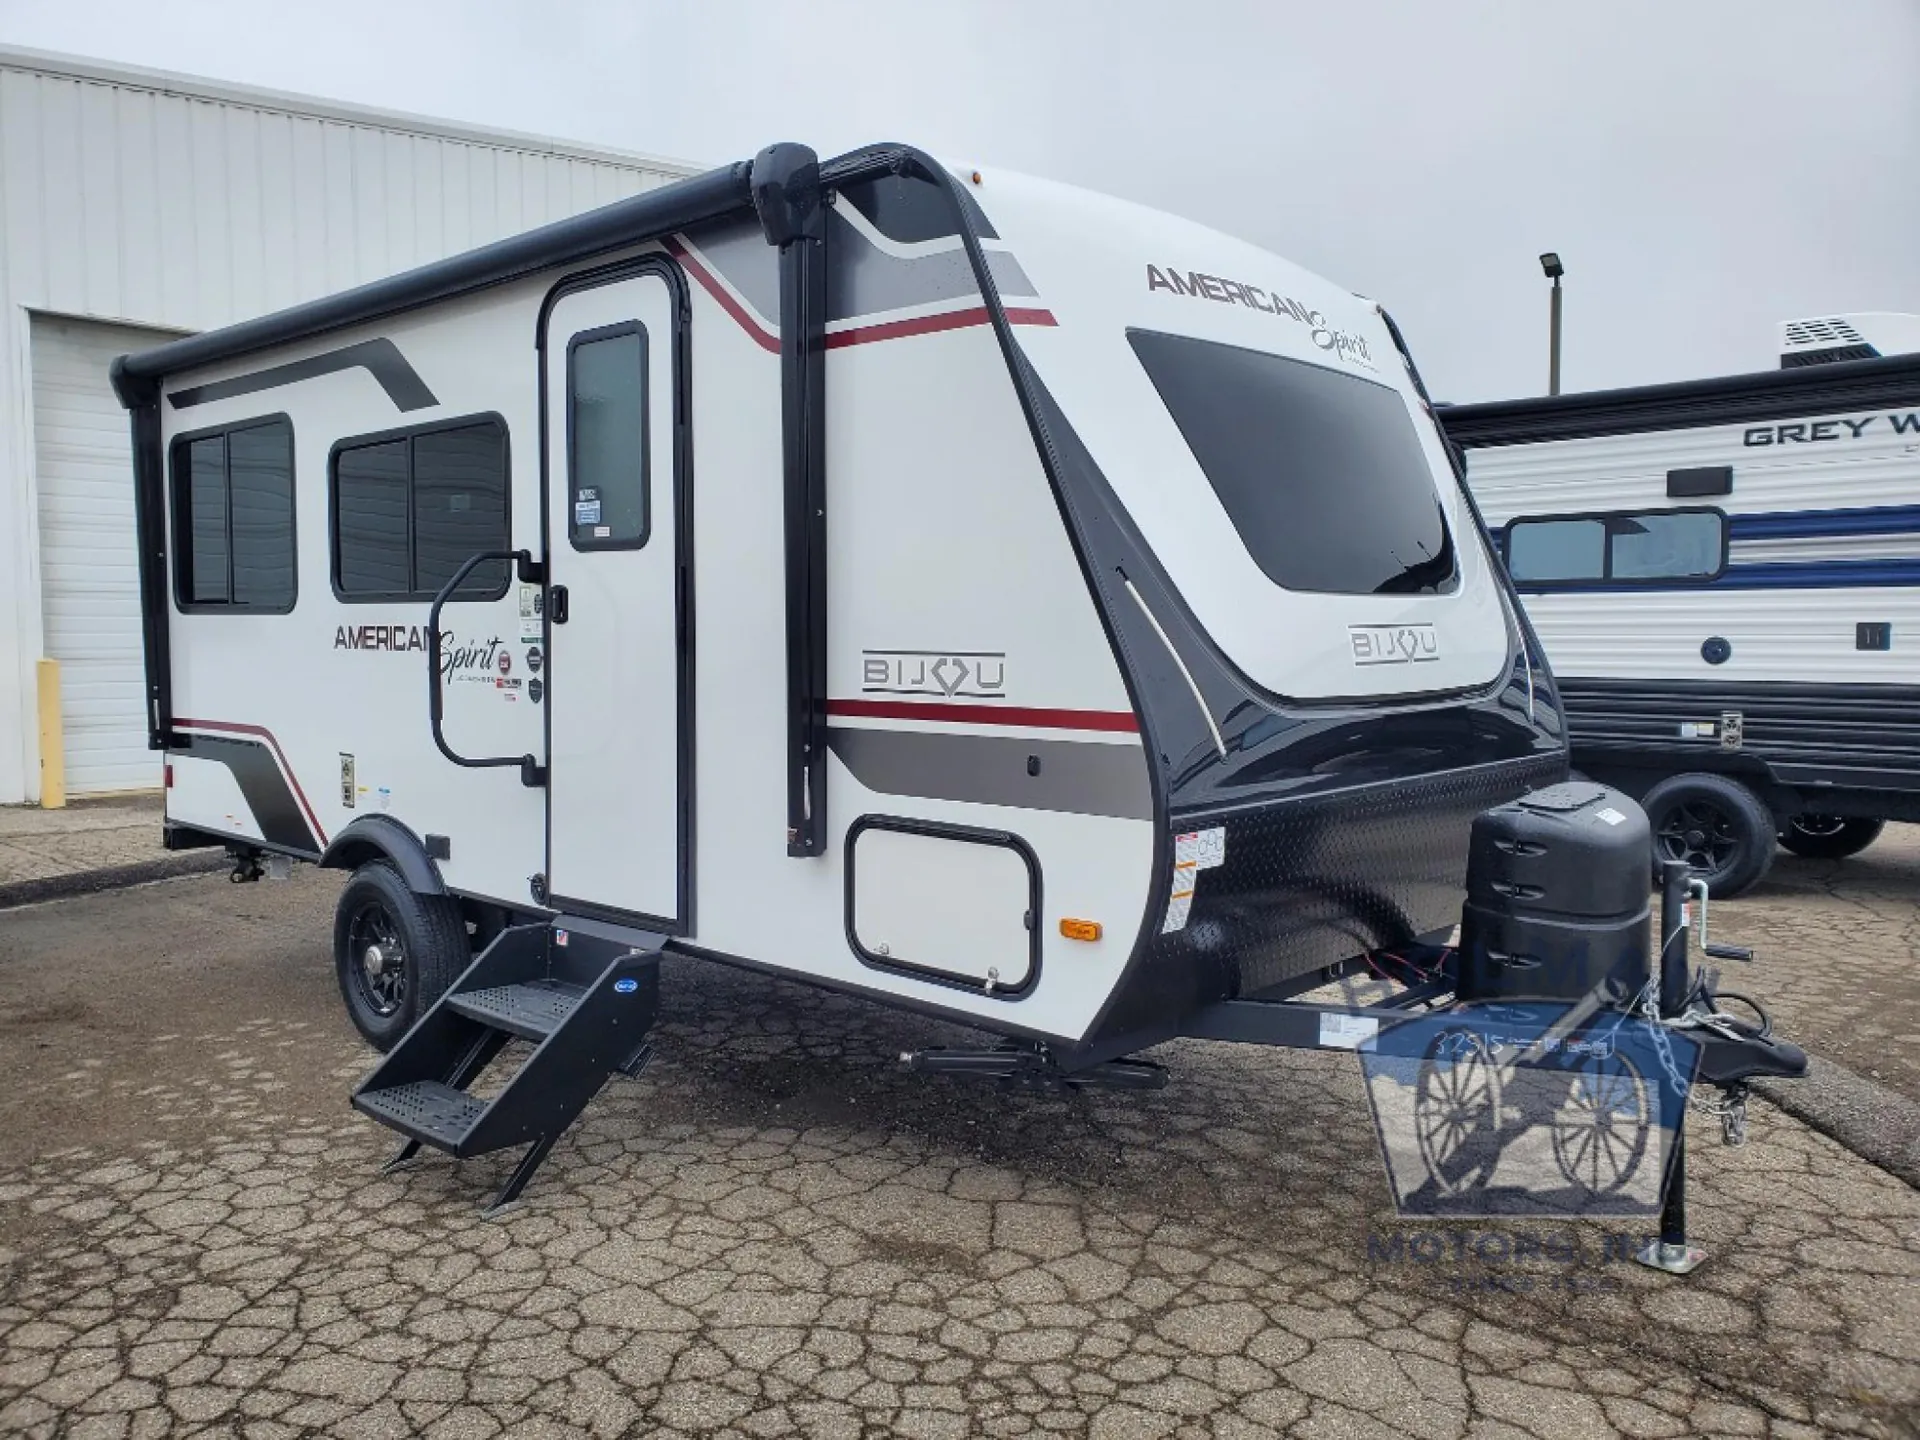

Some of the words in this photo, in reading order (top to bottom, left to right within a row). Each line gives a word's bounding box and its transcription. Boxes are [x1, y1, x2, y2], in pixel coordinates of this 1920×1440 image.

[1146, 263, 1314, 328] AMERICAN
[1311, 310, 1371, 361] Spirit
[1743, 416, 1877, 446] GREY
[440, 630, 504, 685] Spirit
[1351, 629, 1437, 662] BIJOU
[863, 657, 1004, 698] BIJOU
